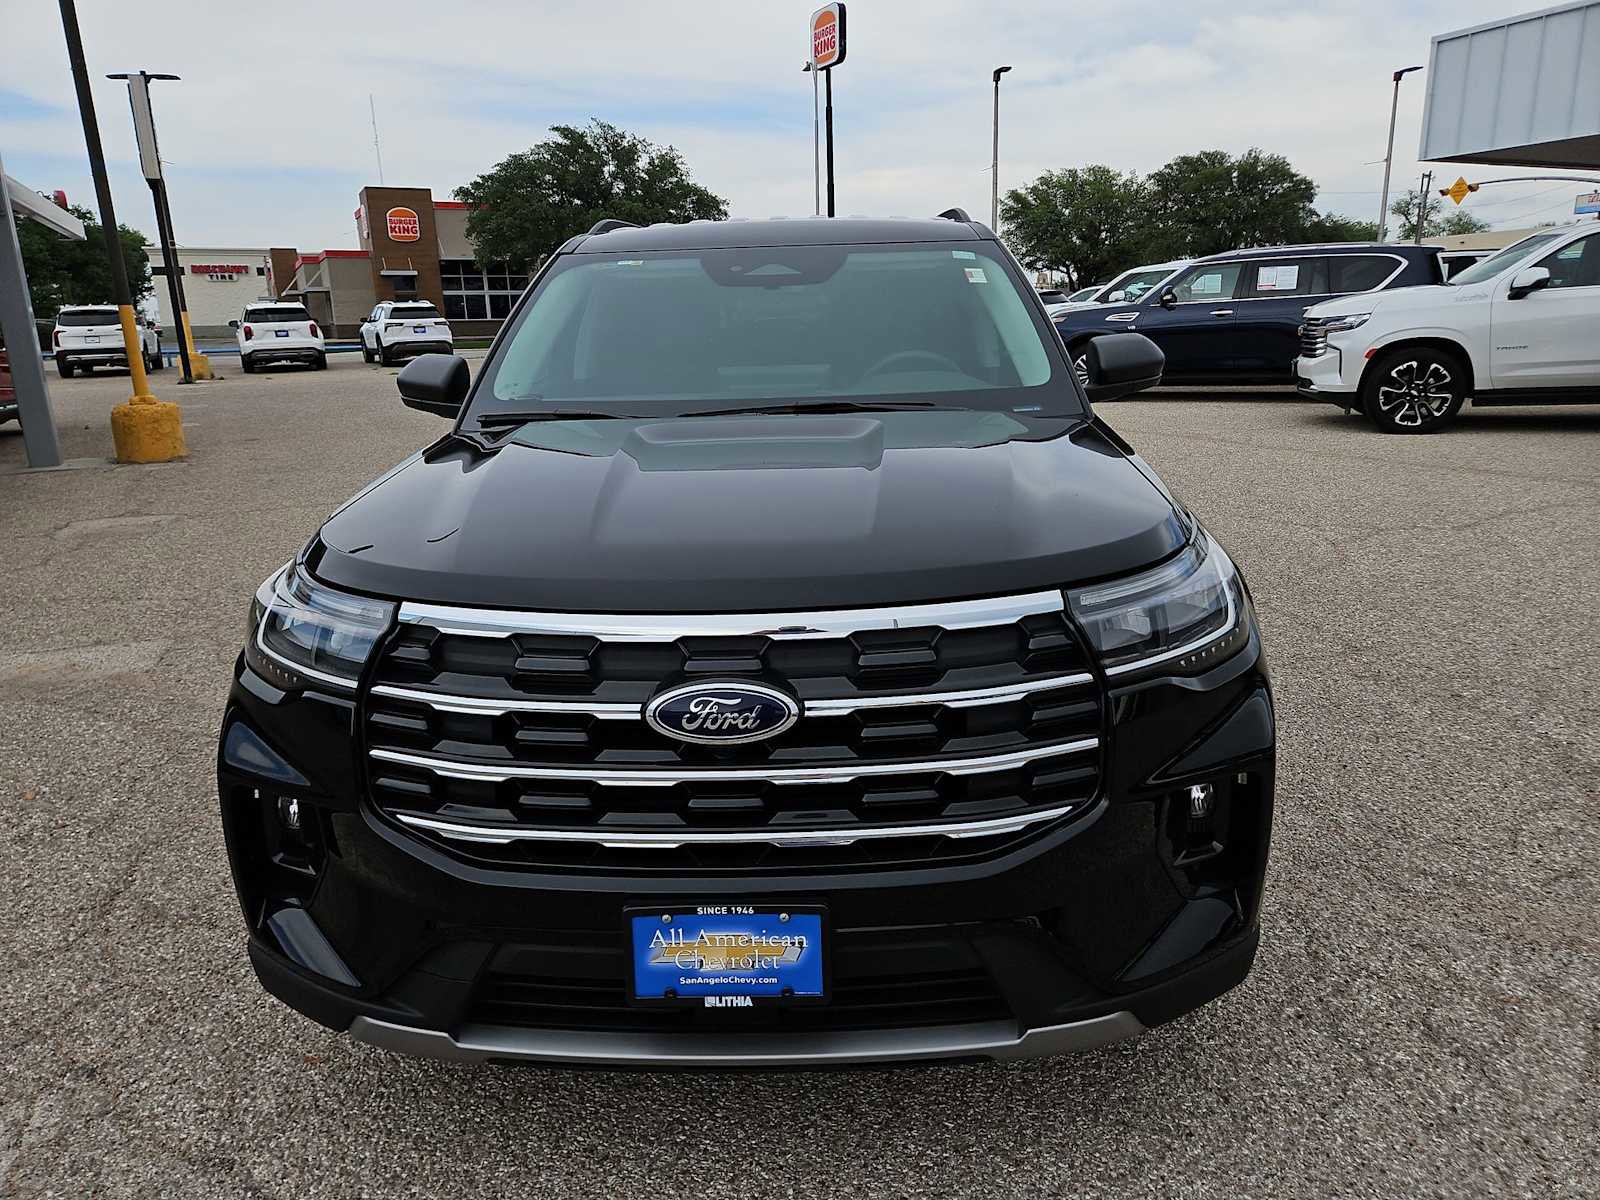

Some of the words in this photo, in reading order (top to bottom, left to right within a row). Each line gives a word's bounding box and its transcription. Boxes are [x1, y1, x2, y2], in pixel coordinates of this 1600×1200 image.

[814, 24, 836, 42] BURGER
[814, 35, 836, 57] KING
[390, 225, 418, 234] KING
[681, 697, 762, 730] Ford
[697, 907, 728, 915] SINCE
[731, 907, 755, 915] 1946
[649, 928, 684, 948] All
[694, 929, 808, 948] American
[675, 949, 781, 970] Chevrolet
[679, 975, 778, 984] SanAngeloChevy.com
[715, 996, 753, 1007] LITHIA
